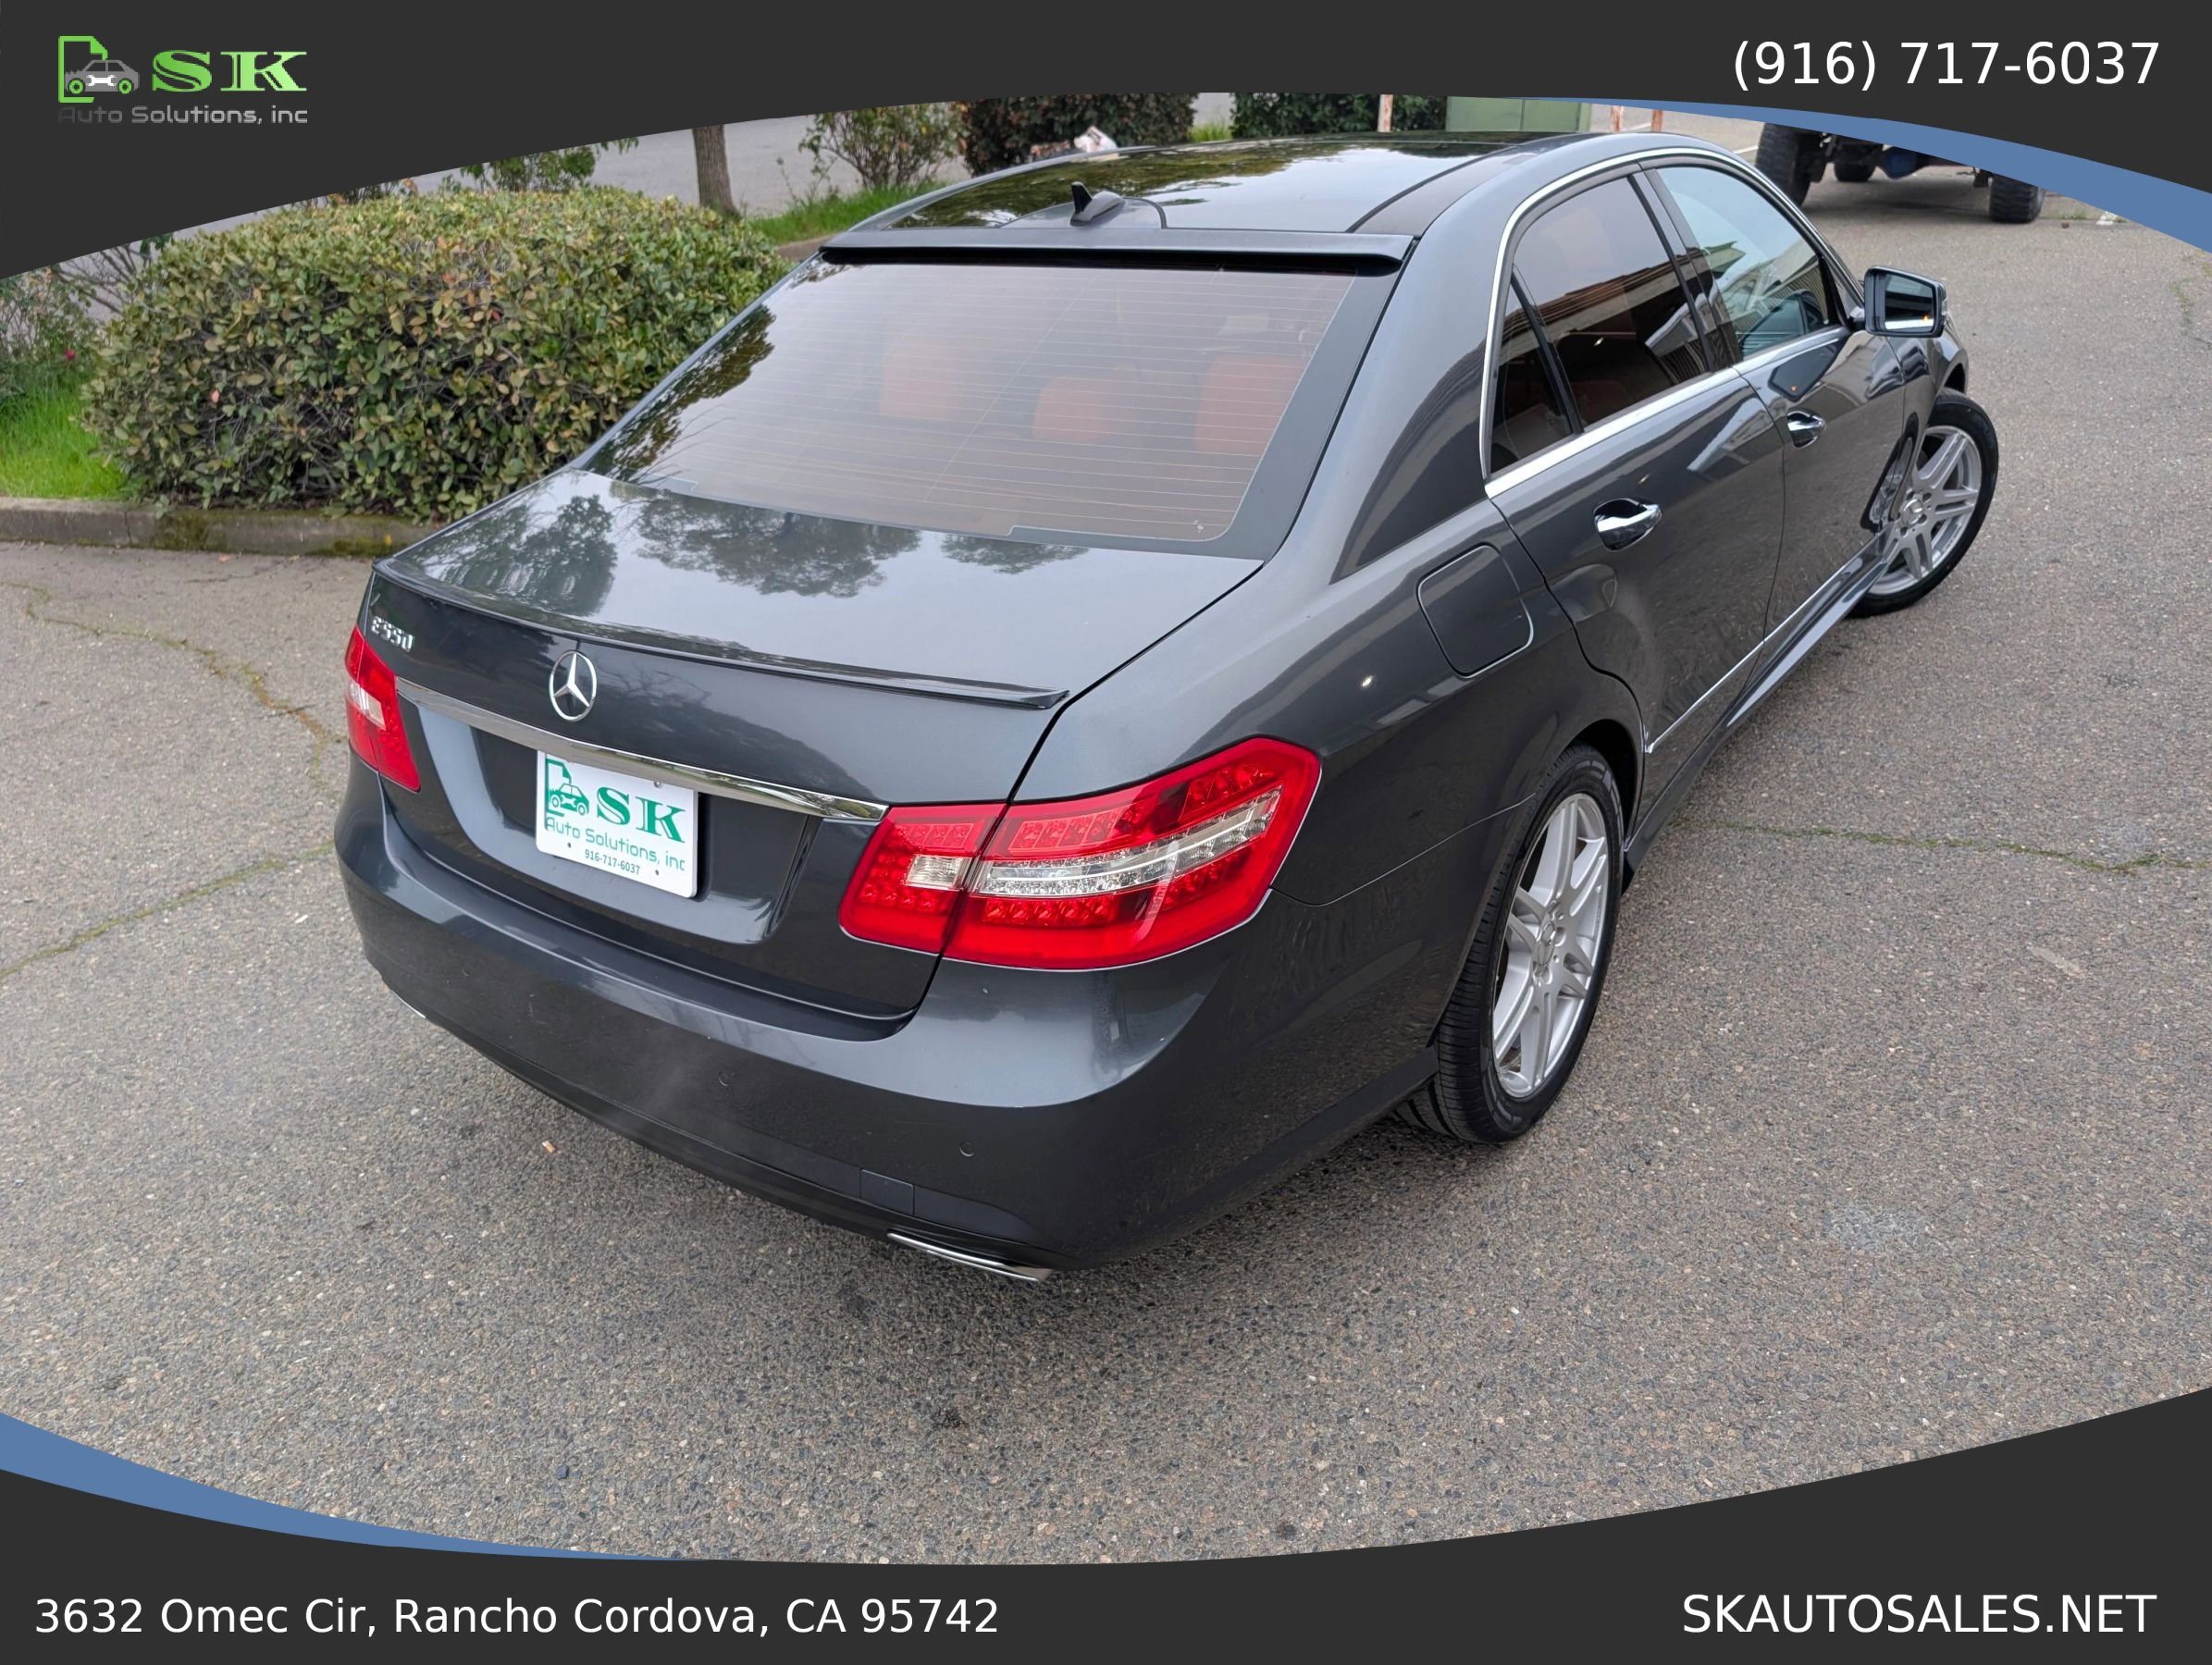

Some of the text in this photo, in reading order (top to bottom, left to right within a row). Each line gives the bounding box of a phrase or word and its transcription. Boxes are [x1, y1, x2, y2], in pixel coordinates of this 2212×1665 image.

[597, 786, 686, 844] SK
[546, 817, 686, 871] Auto Solutions, inc
[585, 848, 641, 875] 916-717-6037
